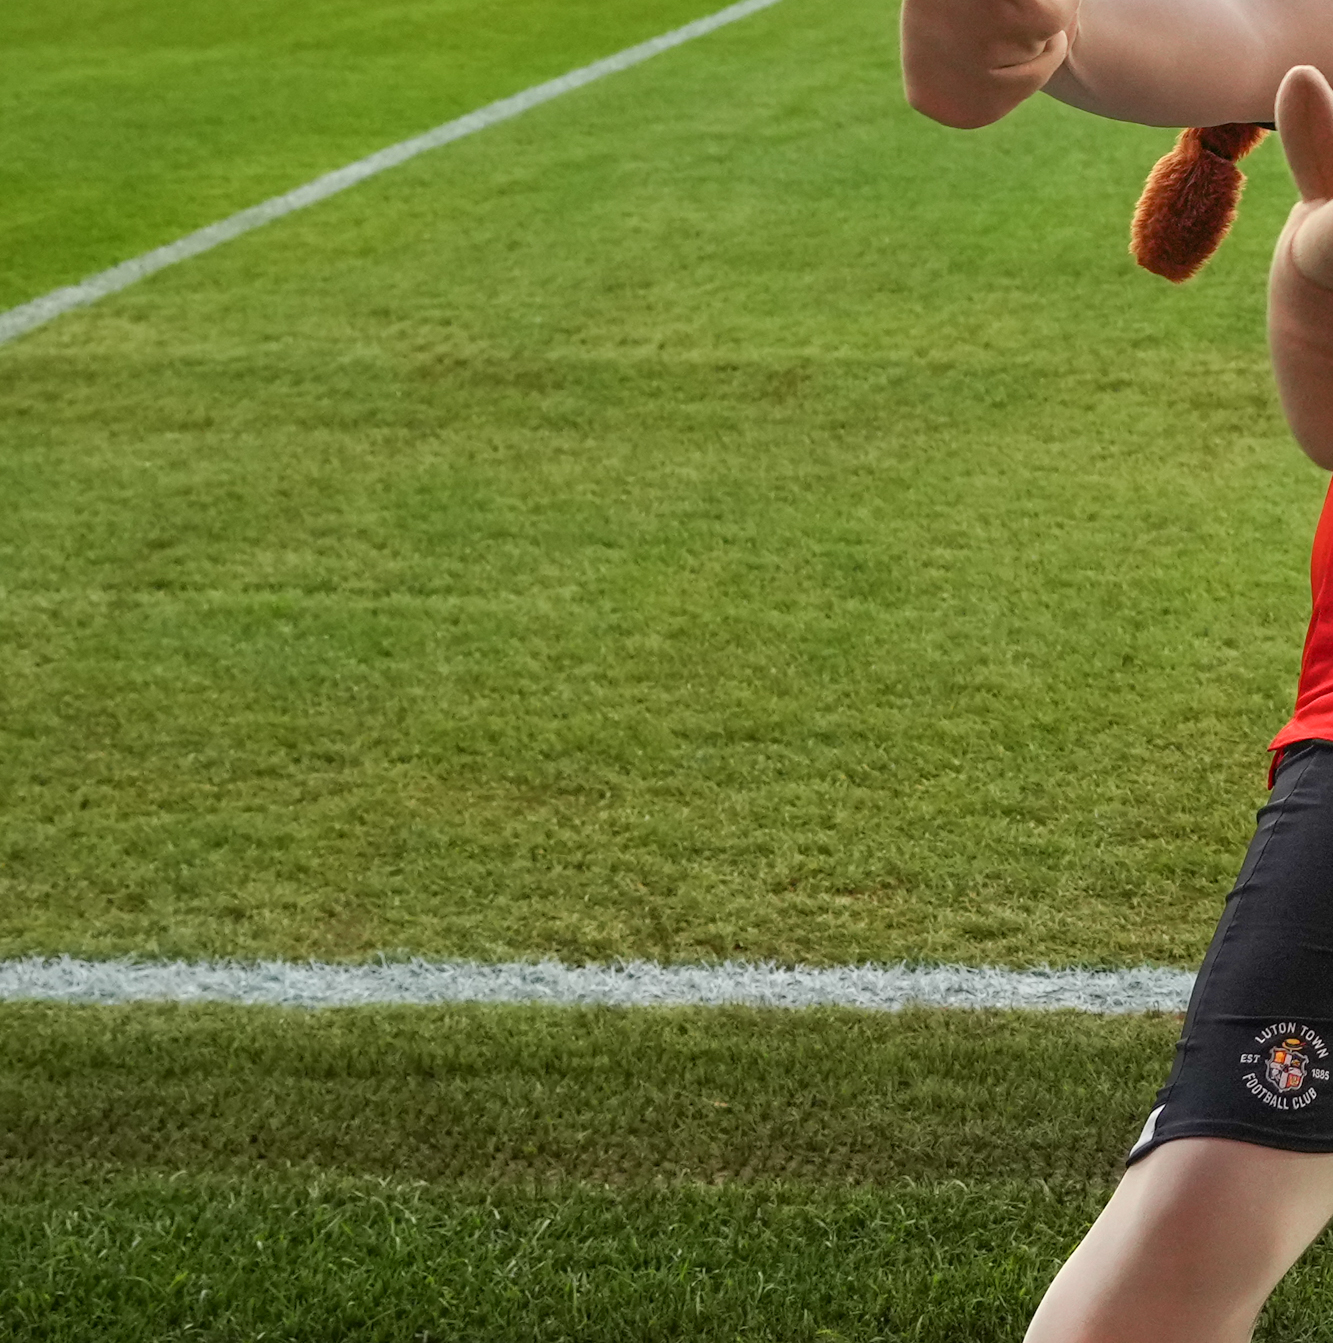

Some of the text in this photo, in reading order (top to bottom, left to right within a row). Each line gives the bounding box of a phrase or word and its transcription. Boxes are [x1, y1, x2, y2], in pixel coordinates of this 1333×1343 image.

[1255, 1022, 1329, 1059] LUTON TOWN
[1240, 1053, 1330, 1081] EST 1885
[1242, 1072, 1317, 1111] FOOTBALL CLUB
